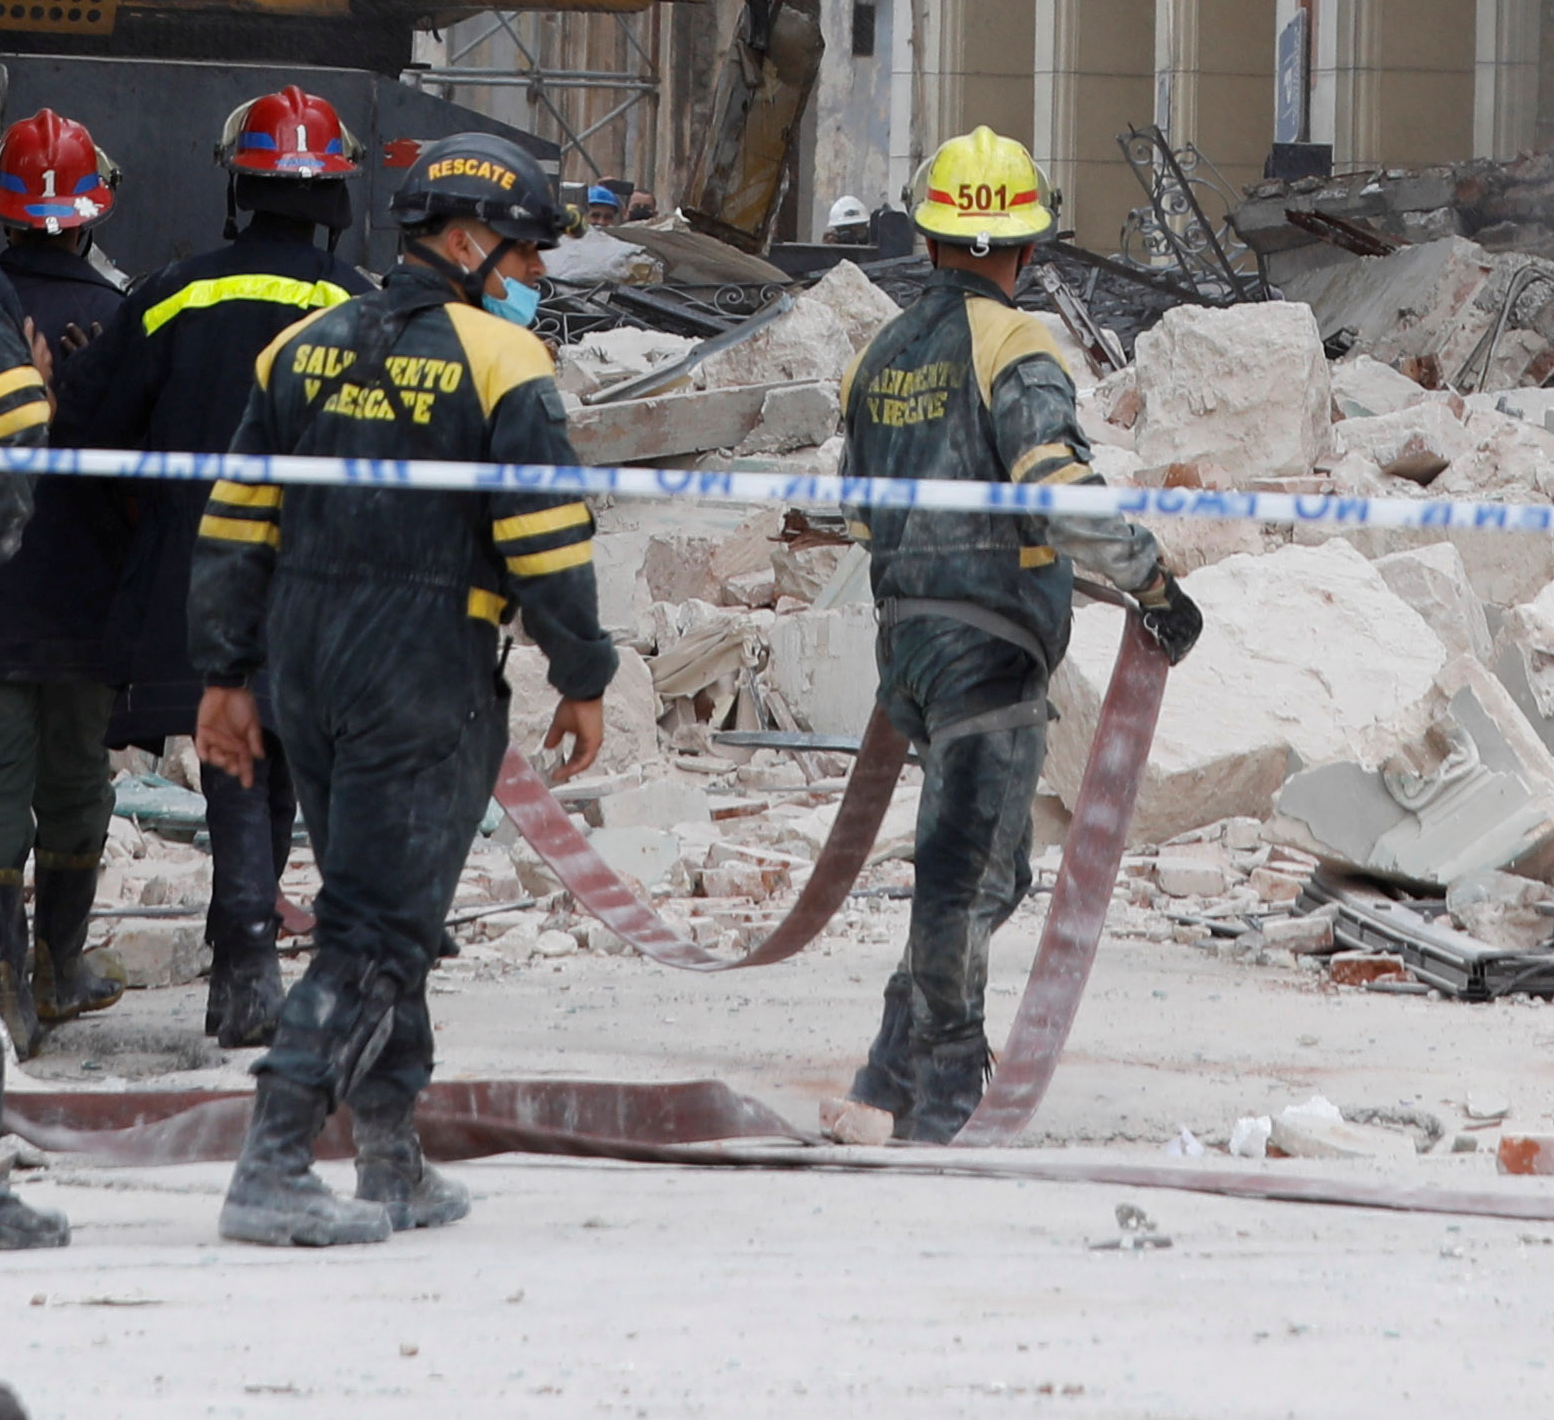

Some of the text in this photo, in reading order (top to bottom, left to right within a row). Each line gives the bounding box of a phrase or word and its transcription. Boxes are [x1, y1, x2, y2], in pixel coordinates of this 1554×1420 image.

[296, 124, 307, 152] 1
[42, 170, 56, 198] 1
[428, 158, 516, 190] RESCATE
[958, 184, 1007, 211] 501
[292, 344, 464, 394] SALVENTO
